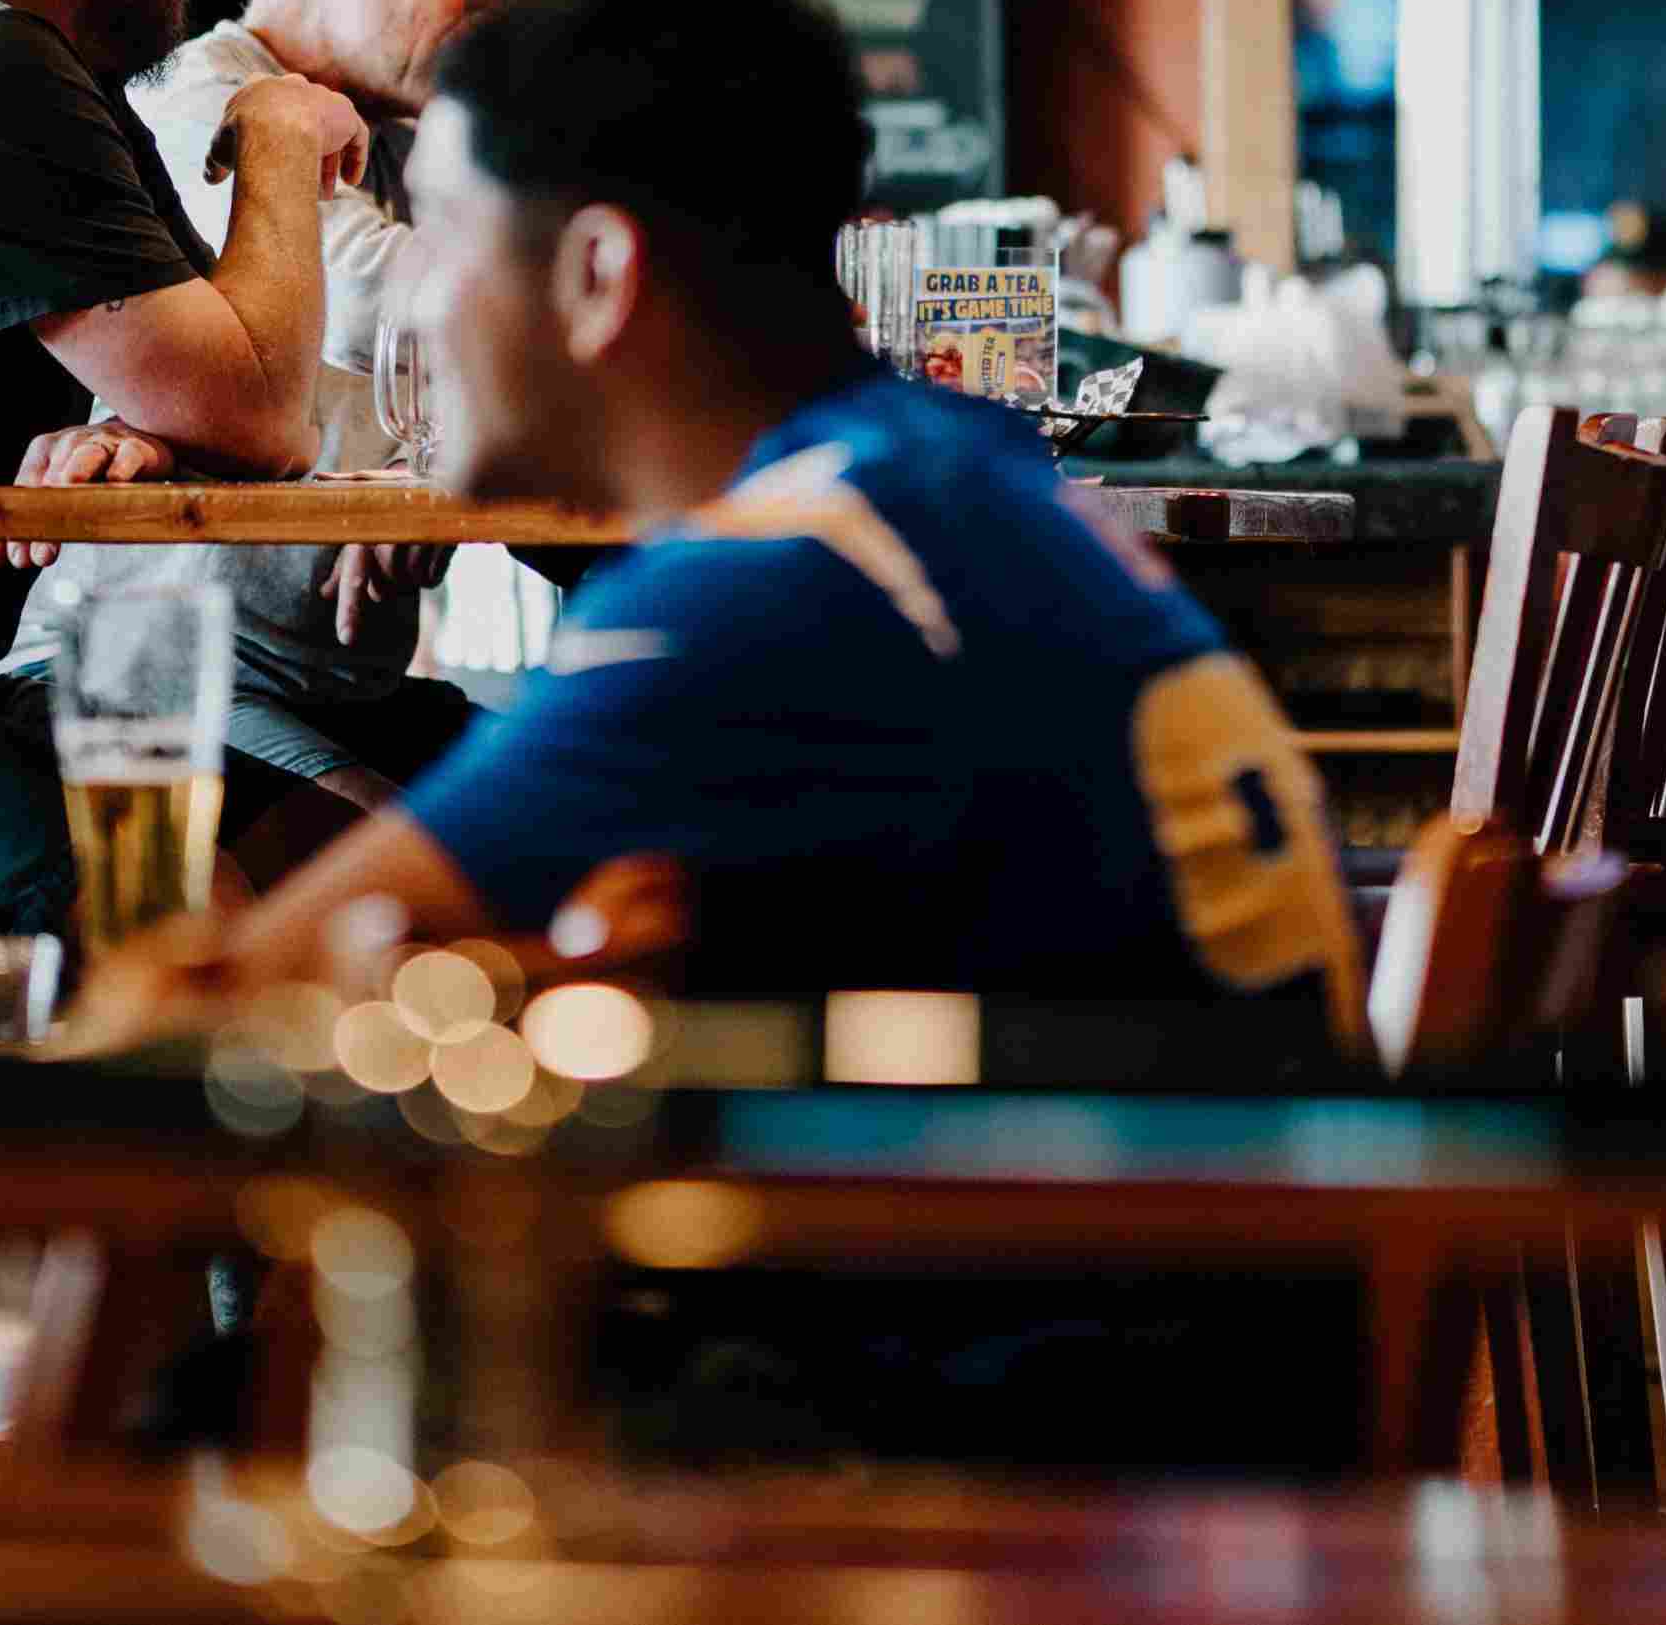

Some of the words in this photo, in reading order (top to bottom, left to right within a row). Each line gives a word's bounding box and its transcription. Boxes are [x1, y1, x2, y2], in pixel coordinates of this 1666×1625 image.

[926, 273, 980, 293] GRAB
[986, 273, 999, 293] A
[917, 299, 958, 322] IT'S
[957, 297, 1006, 319] GAME
[1008, 295, 1055, 318] TIME
